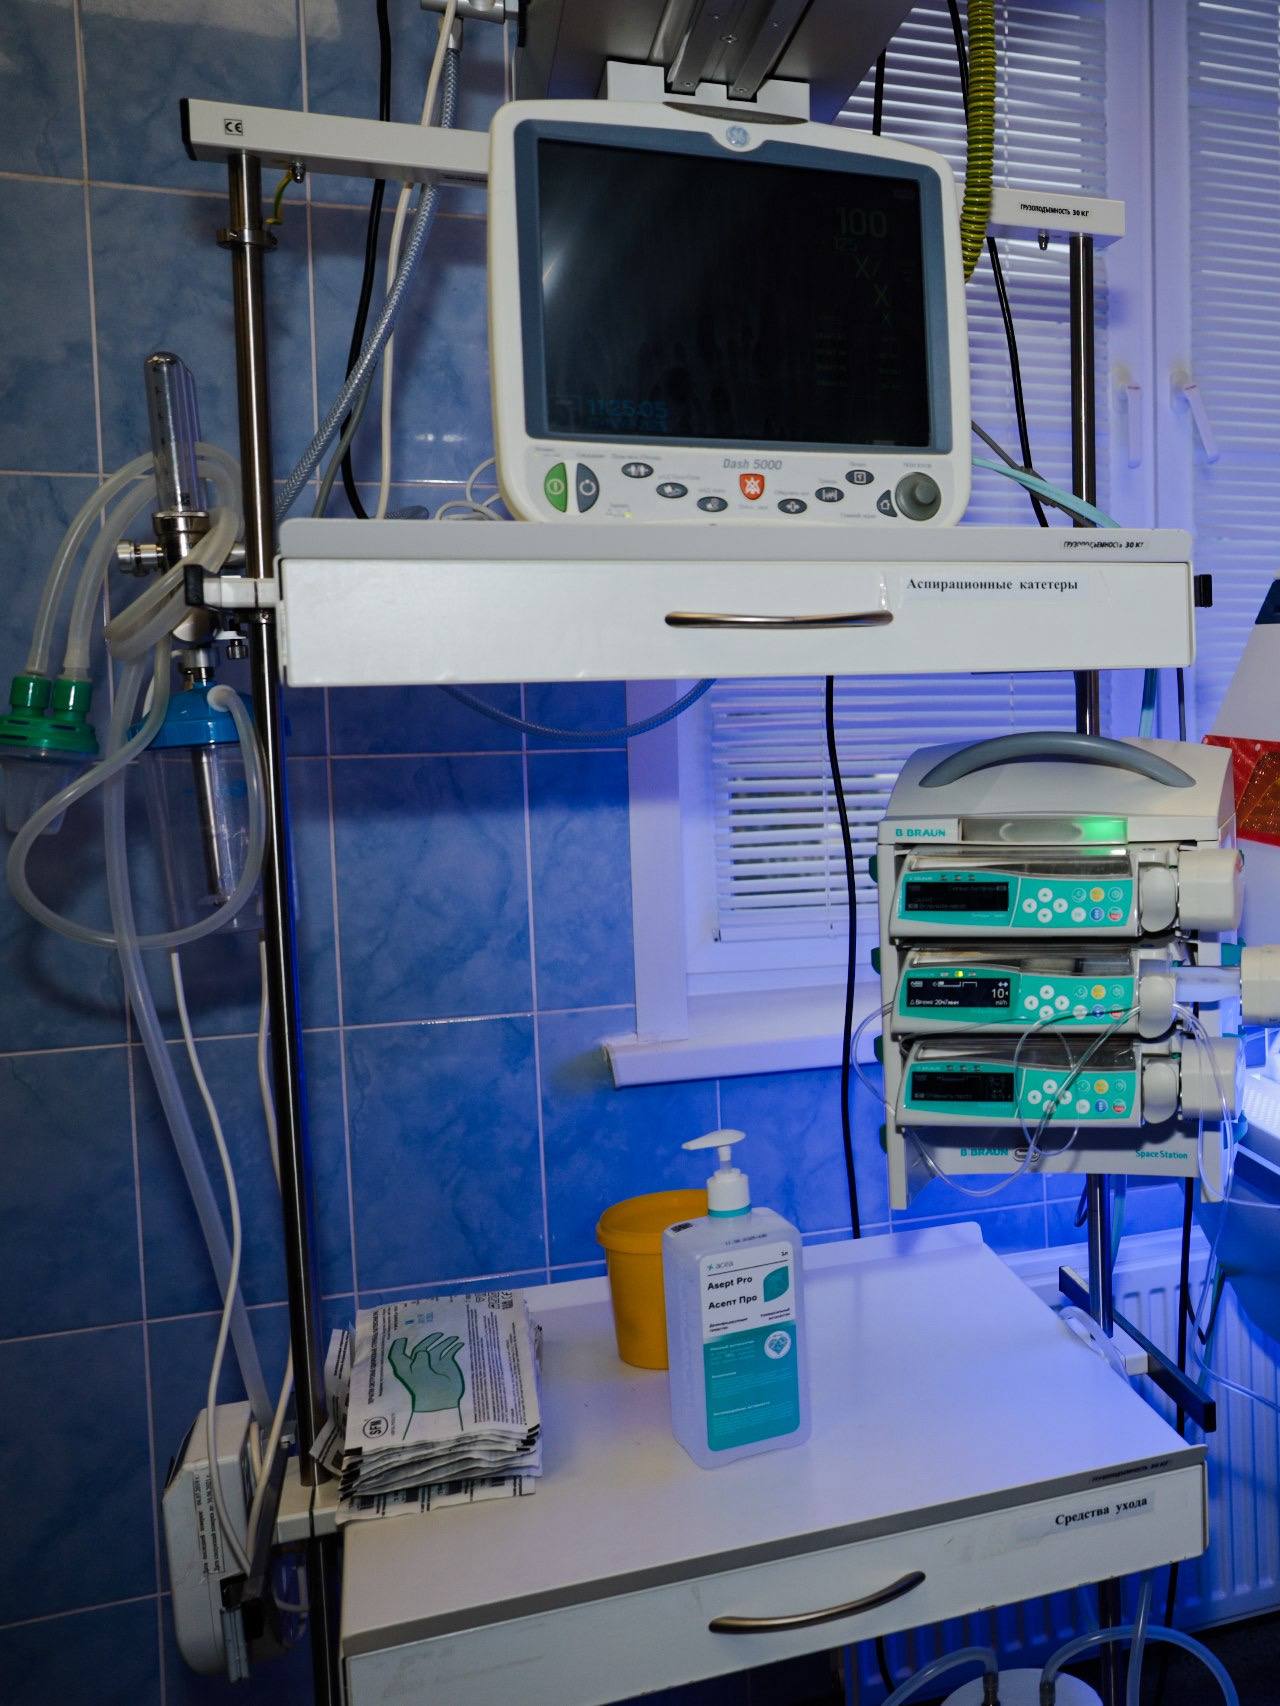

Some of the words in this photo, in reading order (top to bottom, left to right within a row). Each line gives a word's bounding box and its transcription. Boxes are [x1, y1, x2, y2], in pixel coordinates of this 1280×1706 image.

[723, 458, 750, 469] Dash
[753, 459, 783, 470] 5000
[906, 578, 1013, 592] Аспирационные
[1019, 581, 1078, 593] катетеры
[907, 828, 945, 837] BRAUN
[971, 1147, 1009, 1156] BRAUN
[707, 1279, 734, 1291] Asept
[736, 1276, 753, 1285] Pro
[708, 1299, 737, 1310] Асепт
[739, 1295, 758, 1305] Про
[369, 1419, 382, 1435] SFM
[1055, 1507, 1110, 1526] Средства
[1115, 1497, 1148, 1515] ухода
